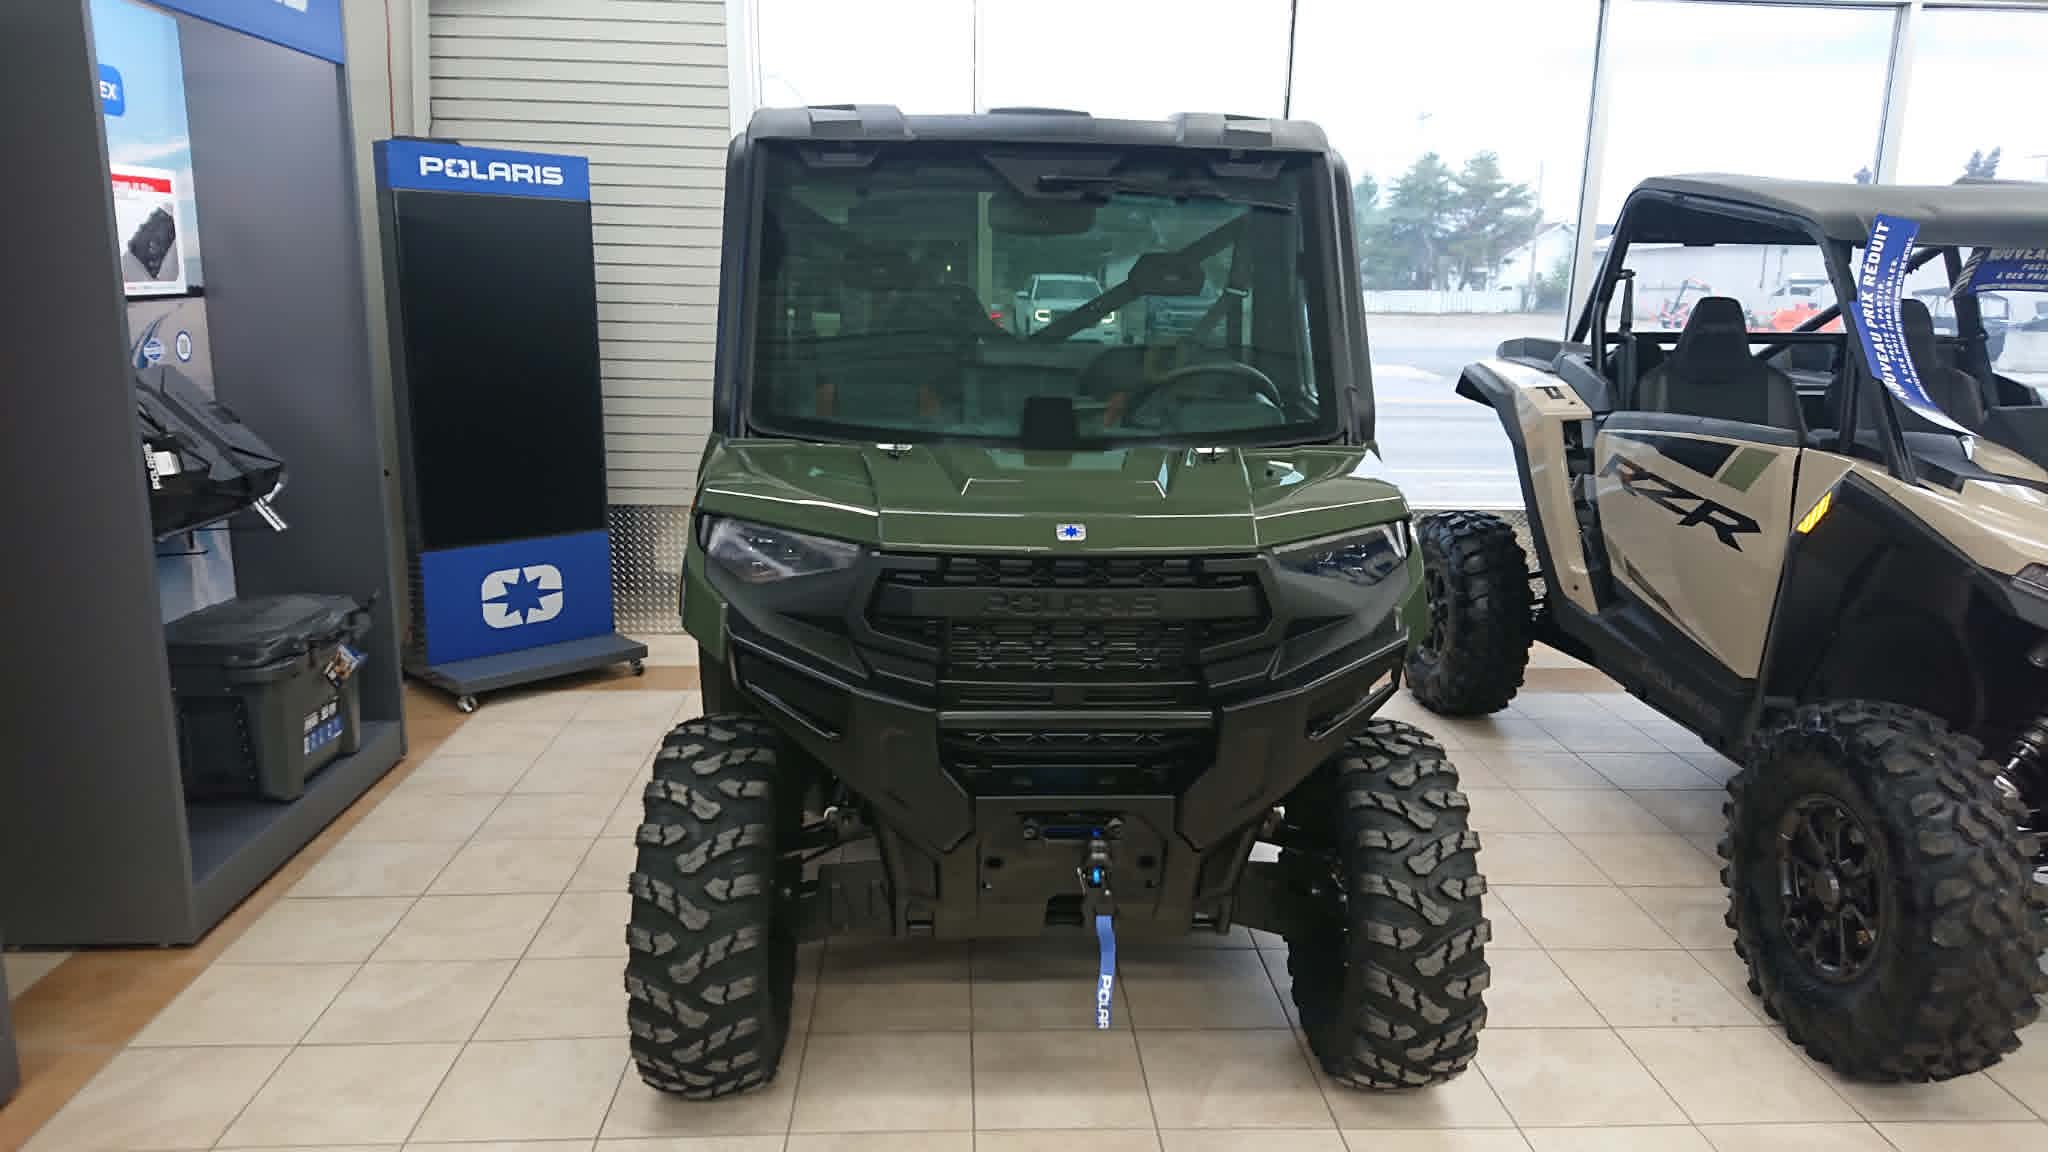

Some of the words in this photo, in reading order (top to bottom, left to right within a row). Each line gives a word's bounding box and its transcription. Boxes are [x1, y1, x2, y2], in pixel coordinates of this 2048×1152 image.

[419, 156, 564, 186] POLARIS
[1863, 221, 1889, 288] RÉDUIT
[1861, 289, 1880, 329] PRIX
[1868, 331, 1912, 400] NOUVEAU
[1598, 453, 1762, 552] RZR
